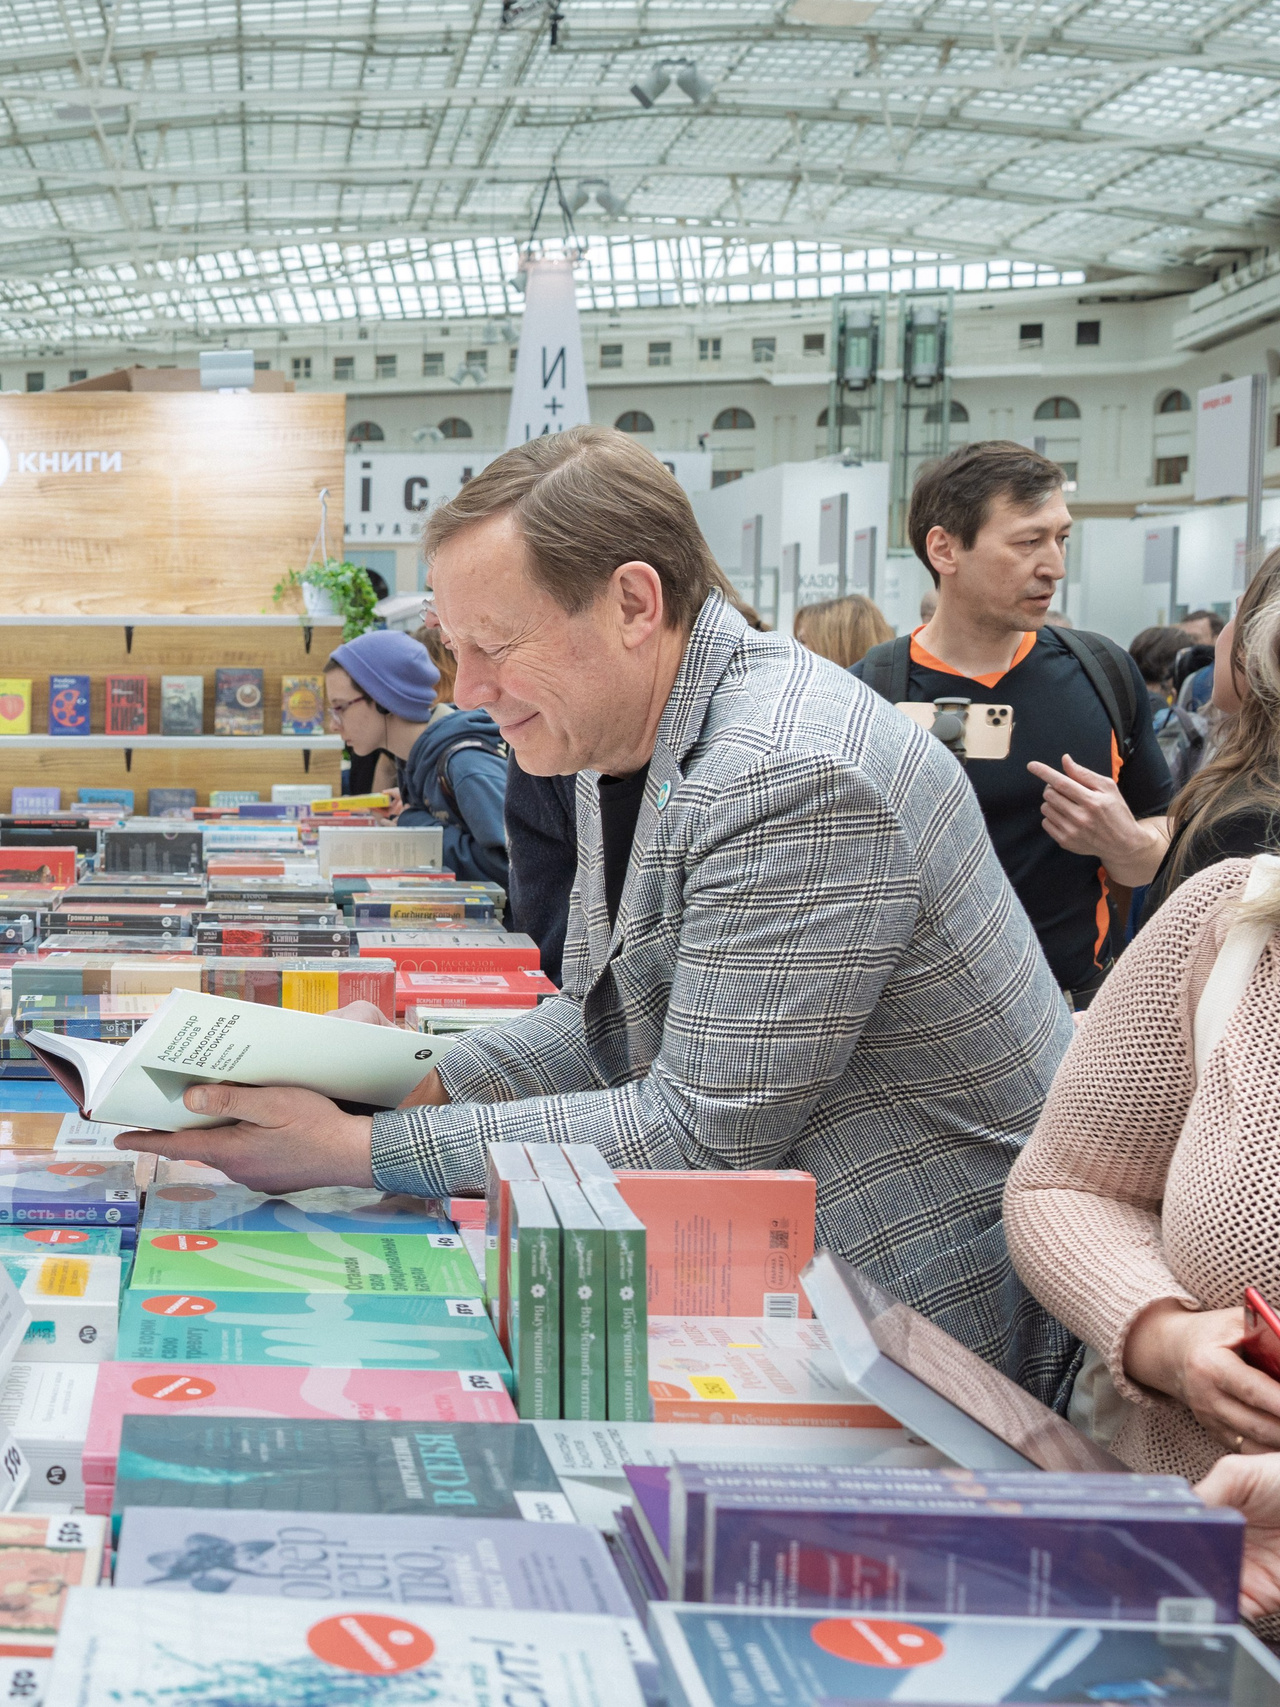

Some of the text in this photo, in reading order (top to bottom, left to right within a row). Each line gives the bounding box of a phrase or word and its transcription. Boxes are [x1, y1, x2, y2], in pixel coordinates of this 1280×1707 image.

[17, 450, 123, 474] книги
[157, 1014, 198, 1062] Александр
[167, 1026, 202, 1063] Асмолов
[182, 1016, 227, 1066] Психология
[195, 1014, 240, 1068] достоинства
[210, 1043, 235, 1070] Искусство
[16, 1208, 55, 1221] есть
[64, 1206, 98, 1220] всё
[344, 1256, 363, 1291] Останови
[369, 1273, 386, 1291] свои
[131, 1319, 161, 1359] Не корми
[161, 1336, 179, 1360] свою
[185, 1326, 209, 1360] тревогу
[532, 1305, 547, 1374] Выученный
[578, 1306, 593, 1377] Выученный
[415, 1433, 478, 1507] В СЕБЯ
